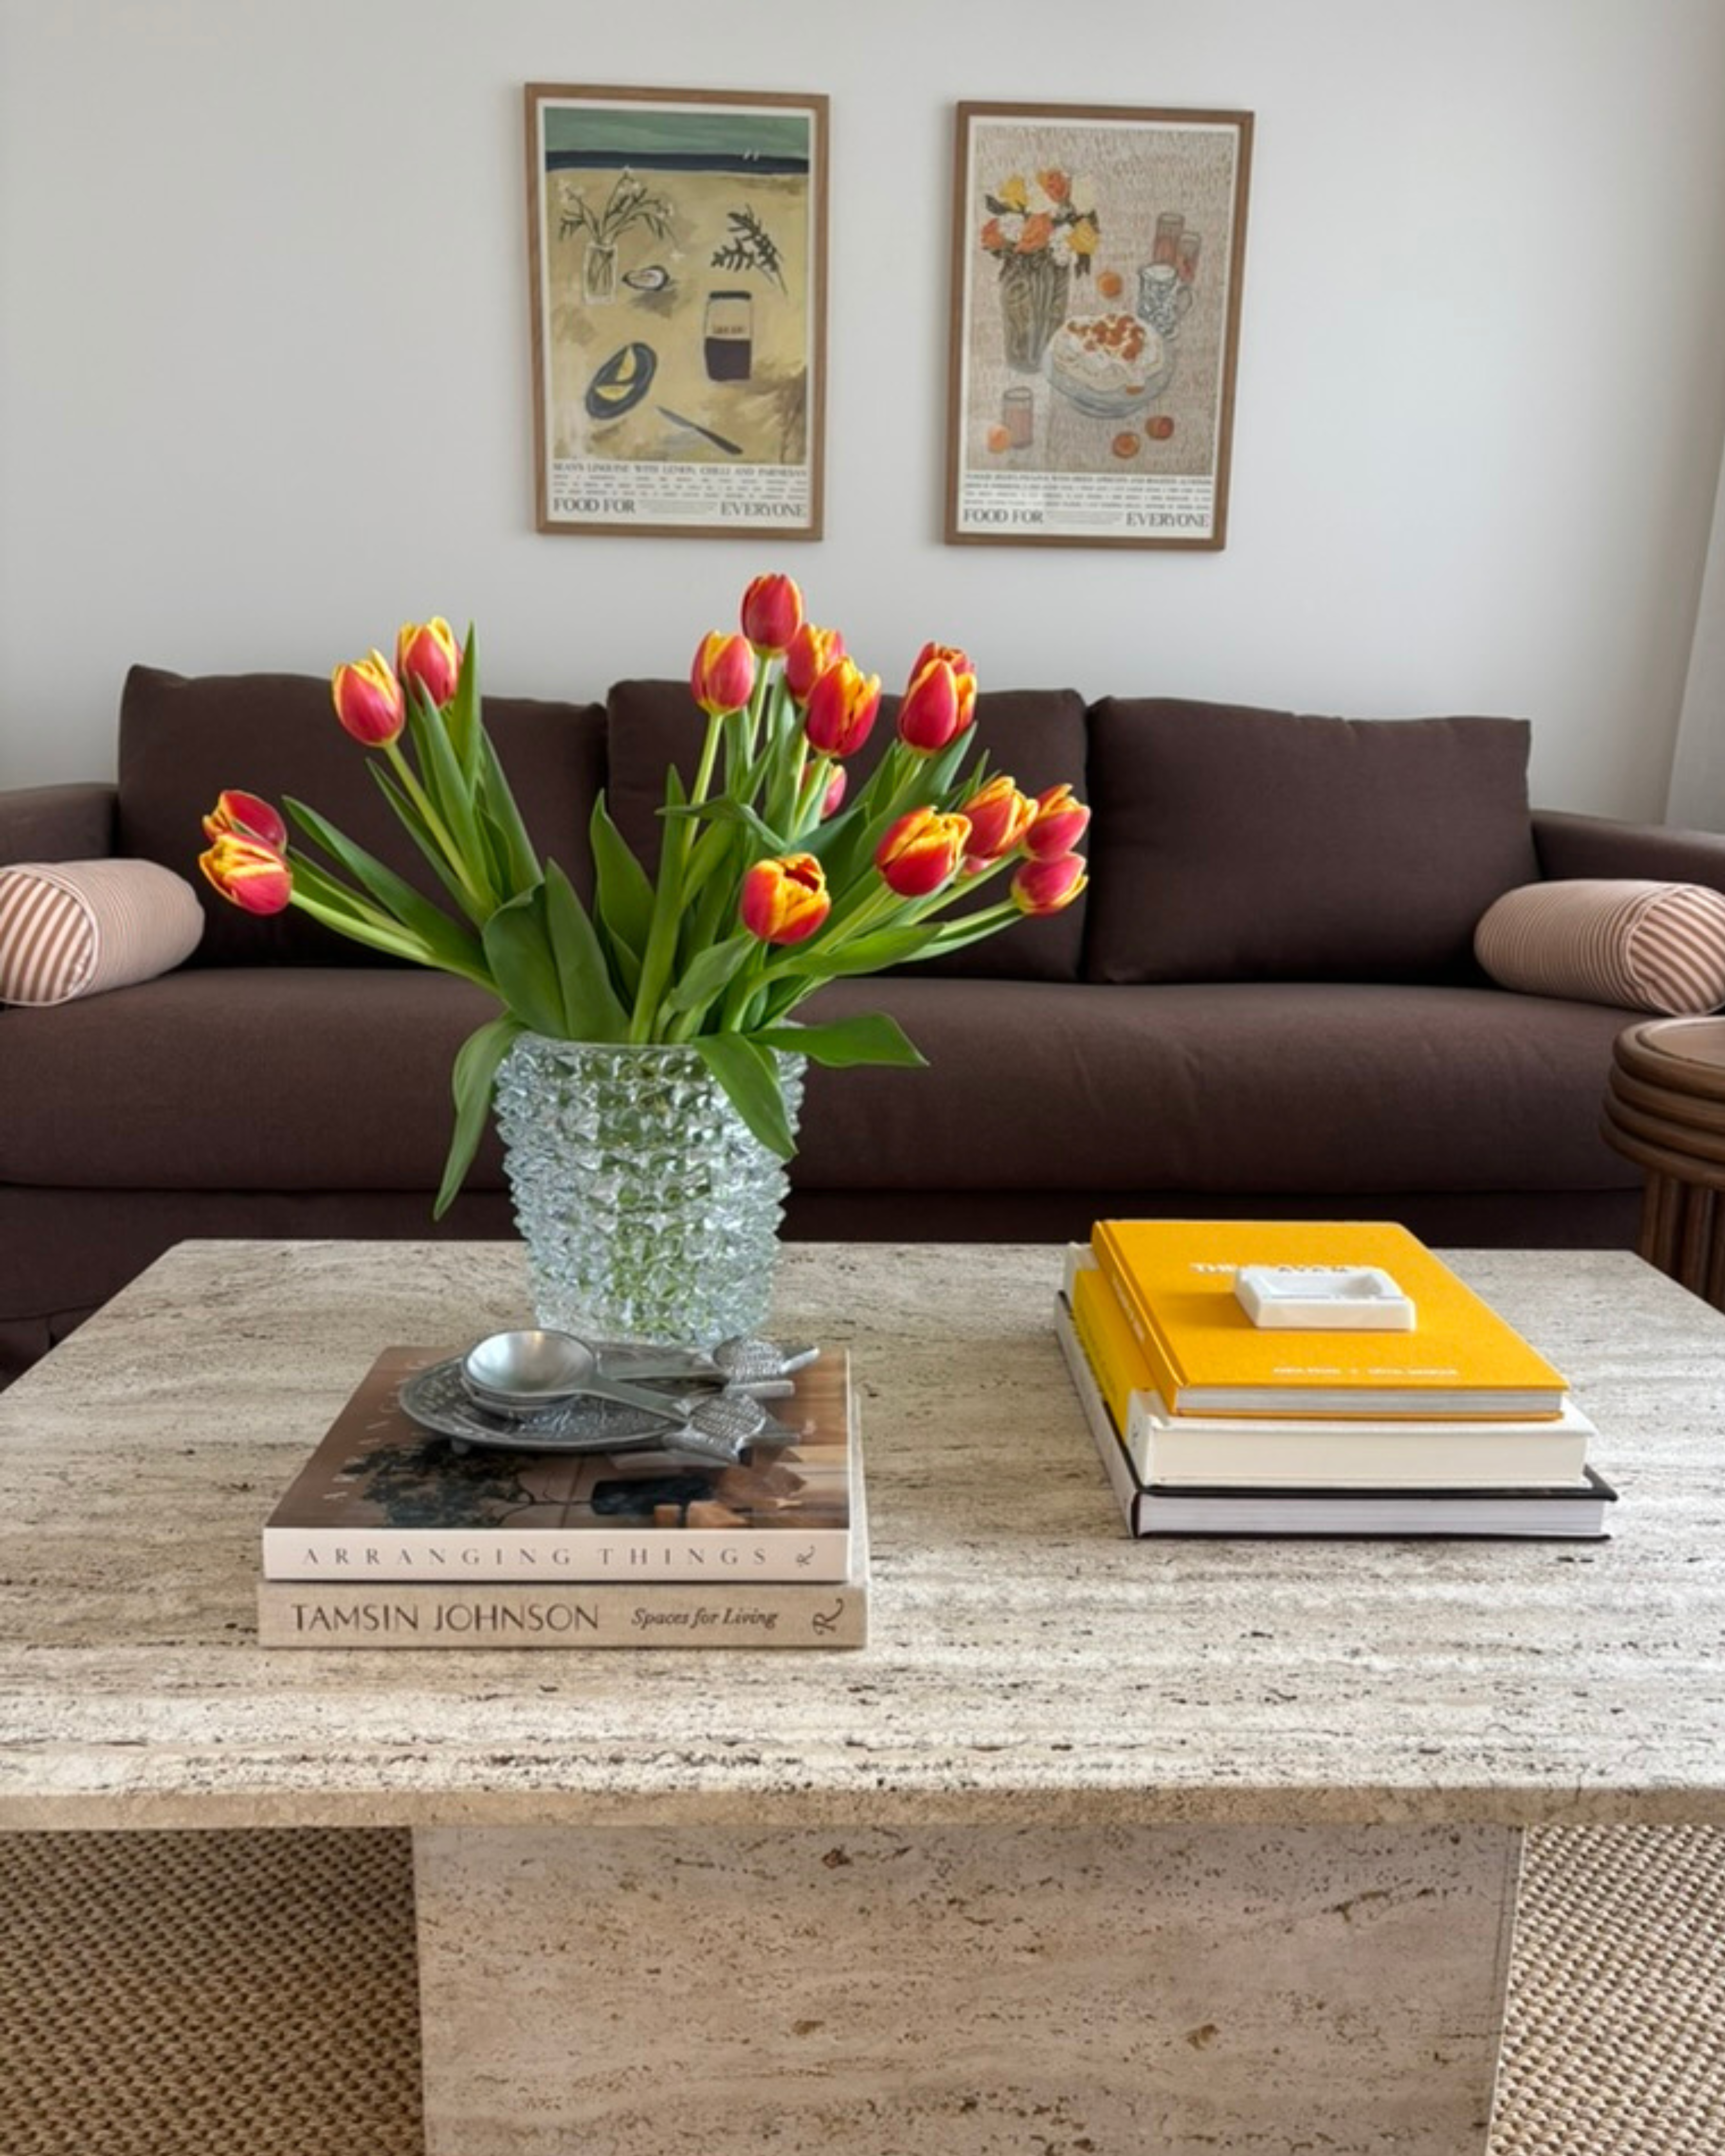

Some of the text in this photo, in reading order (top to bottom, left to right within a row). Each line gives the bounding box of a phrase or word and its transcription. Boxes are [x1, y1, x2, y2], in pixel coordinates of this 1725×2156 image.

[635, 464, 658, 473] WITH
[734, 466, 754, 475] AND
[554, 497, 600, 512] FOOD
[604, 498, 635, 513] FOR
[721, 502, 806, 517] EVERYONE
[963, 508, 1008, 522] FOOD
[1012, 509, 1044, 524] FOR
[1126, 512, 1209, 527] EVERYONE
[1189, 1261, 1237, 1273] THE
[303, 1546, 572, 1566] ARRANGING
[599, 1547, 768, 1566] THINGS
[292, 1604, 419, 1631] TAMSIN
[434, 1603, 599, 1632] JOHNSON
[631, 1606, 689, 1628] Spaces
[689, 1606, 720, 1630] for
[721, 1606, 779, 1630] Living
